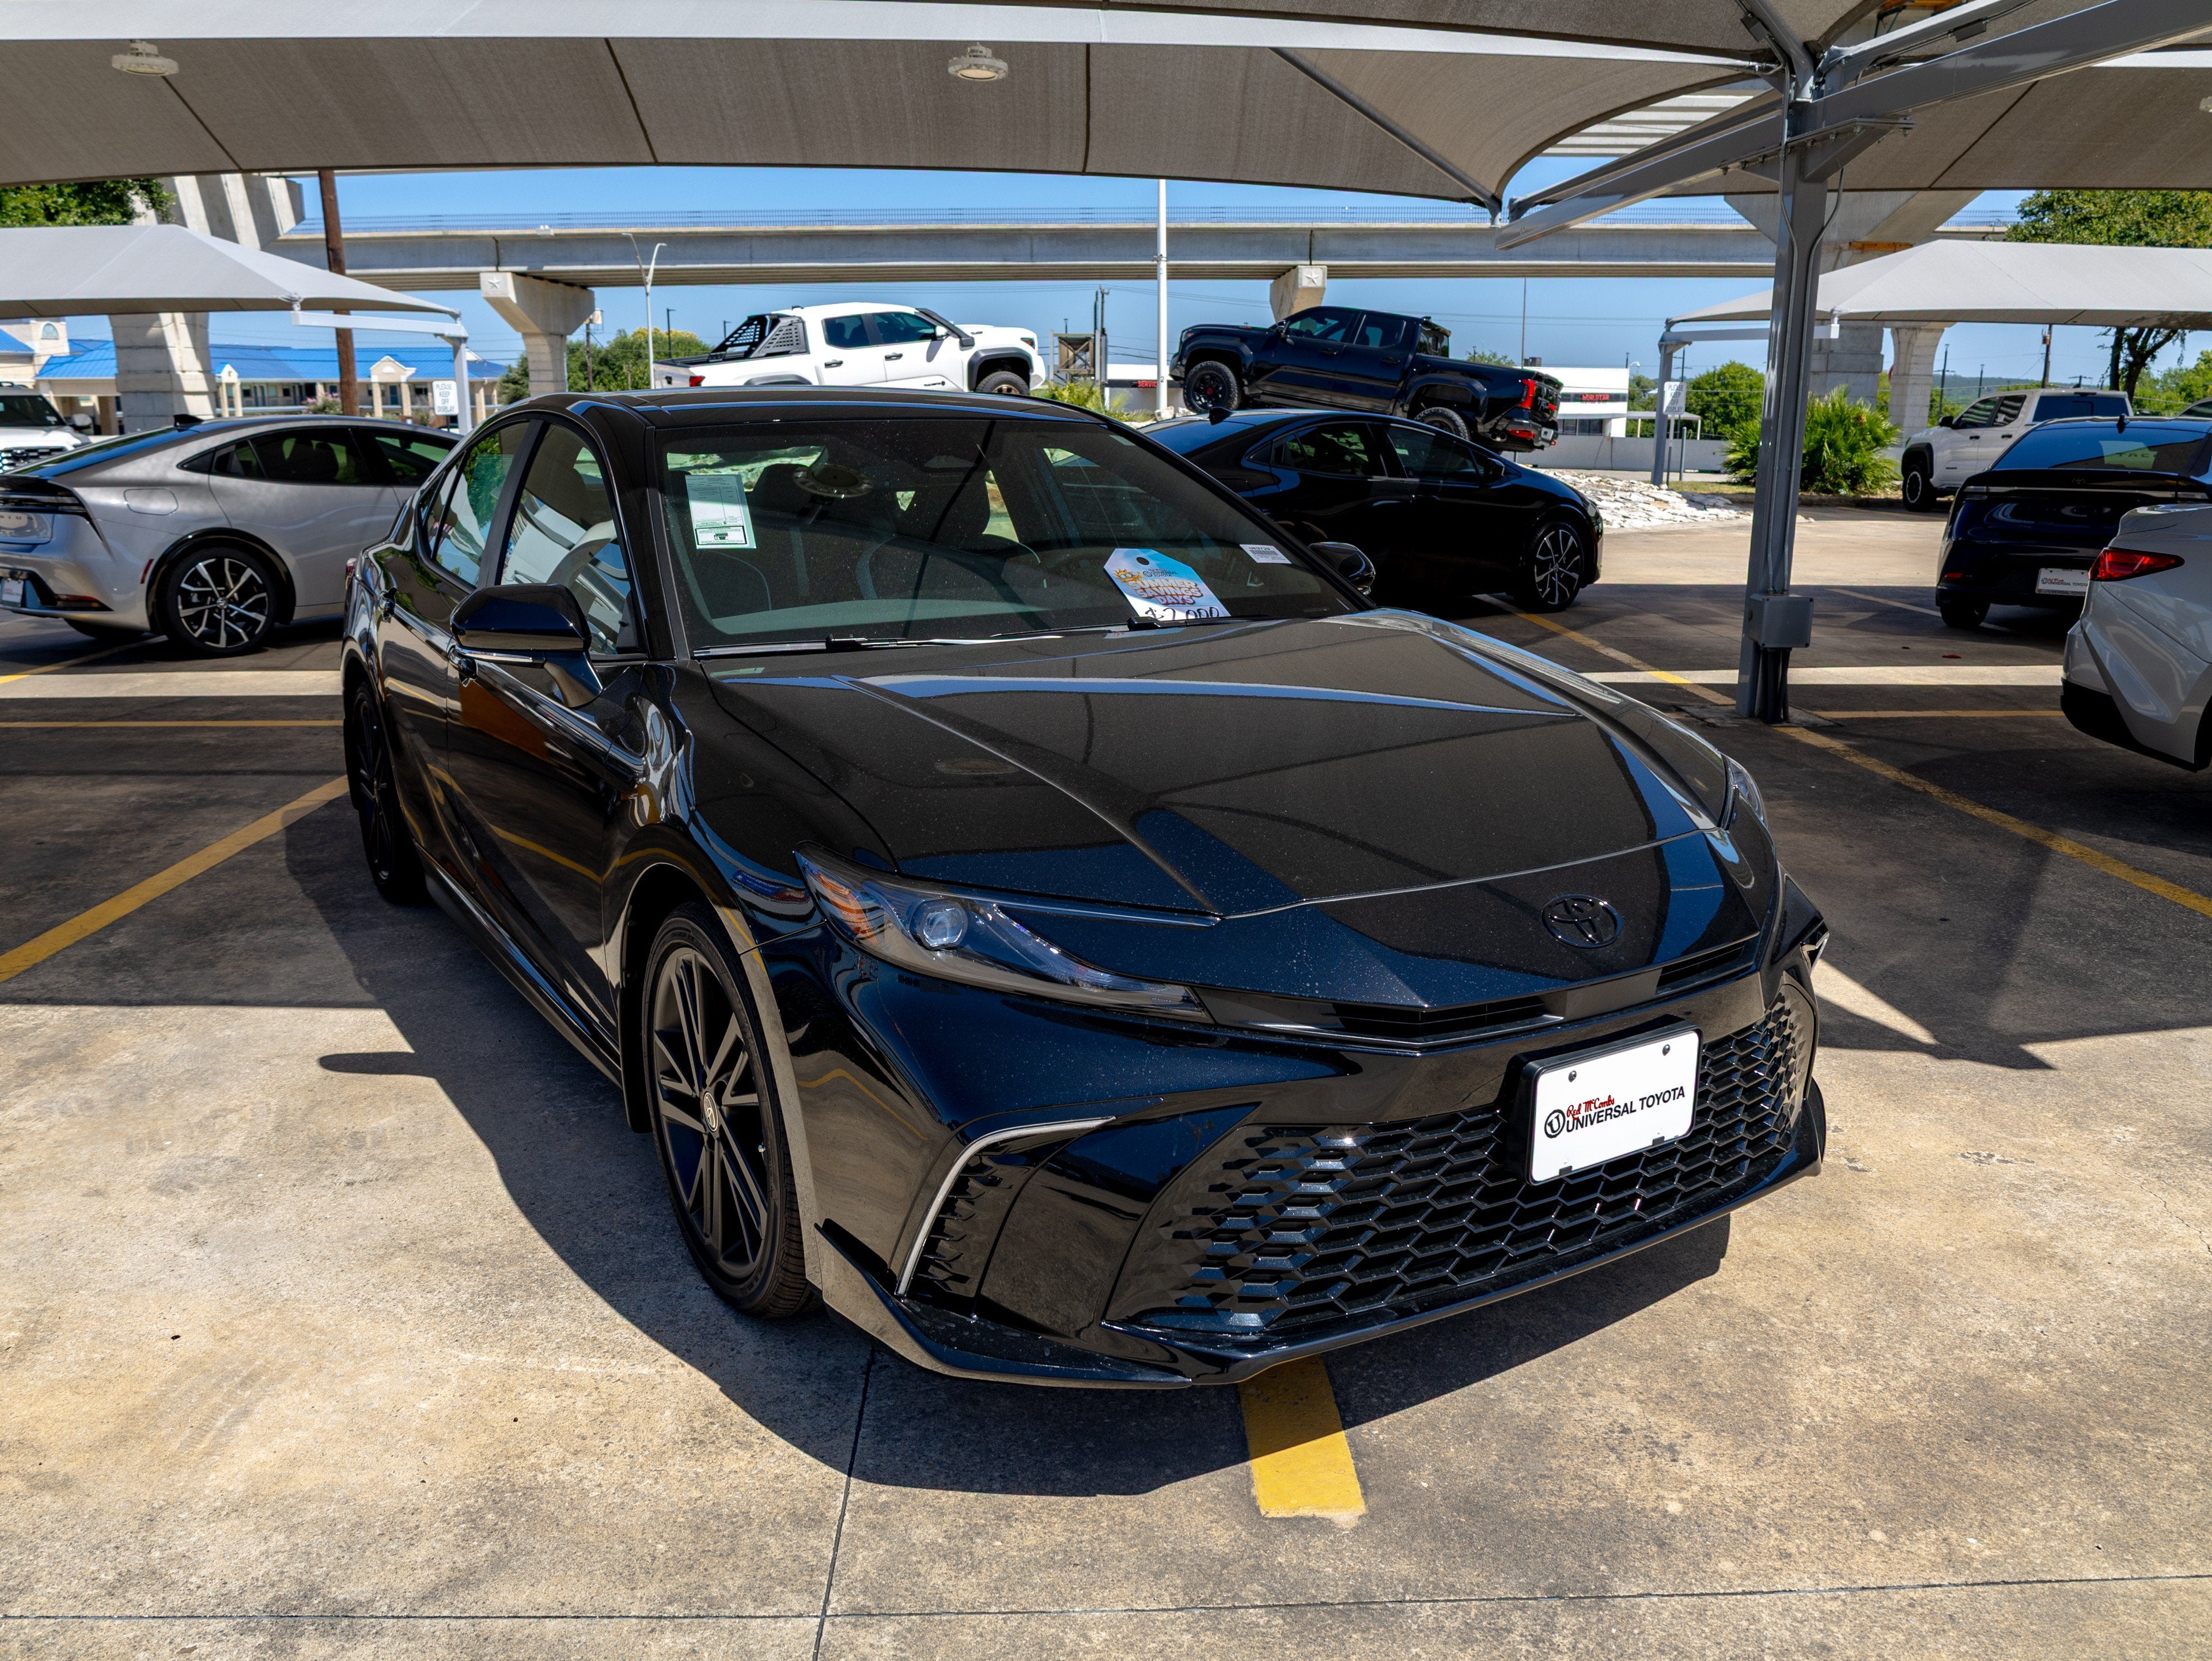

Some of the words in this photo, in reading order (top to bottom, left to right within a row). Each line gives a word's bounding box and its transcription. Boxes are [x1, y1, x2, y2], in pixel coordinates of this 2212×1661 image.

[1128, 578, 1197, 589] SUMMER
[1135, 587, 1203, 598] SAVINGS
[1154, 595, 1195, 605] DAYS
[1566, 1101, 1637, 1133] UNIVERSAL
[1639, 1086, 1685, 1110] TOYOTA
[1567, 1103, 1582, 1120] Red
